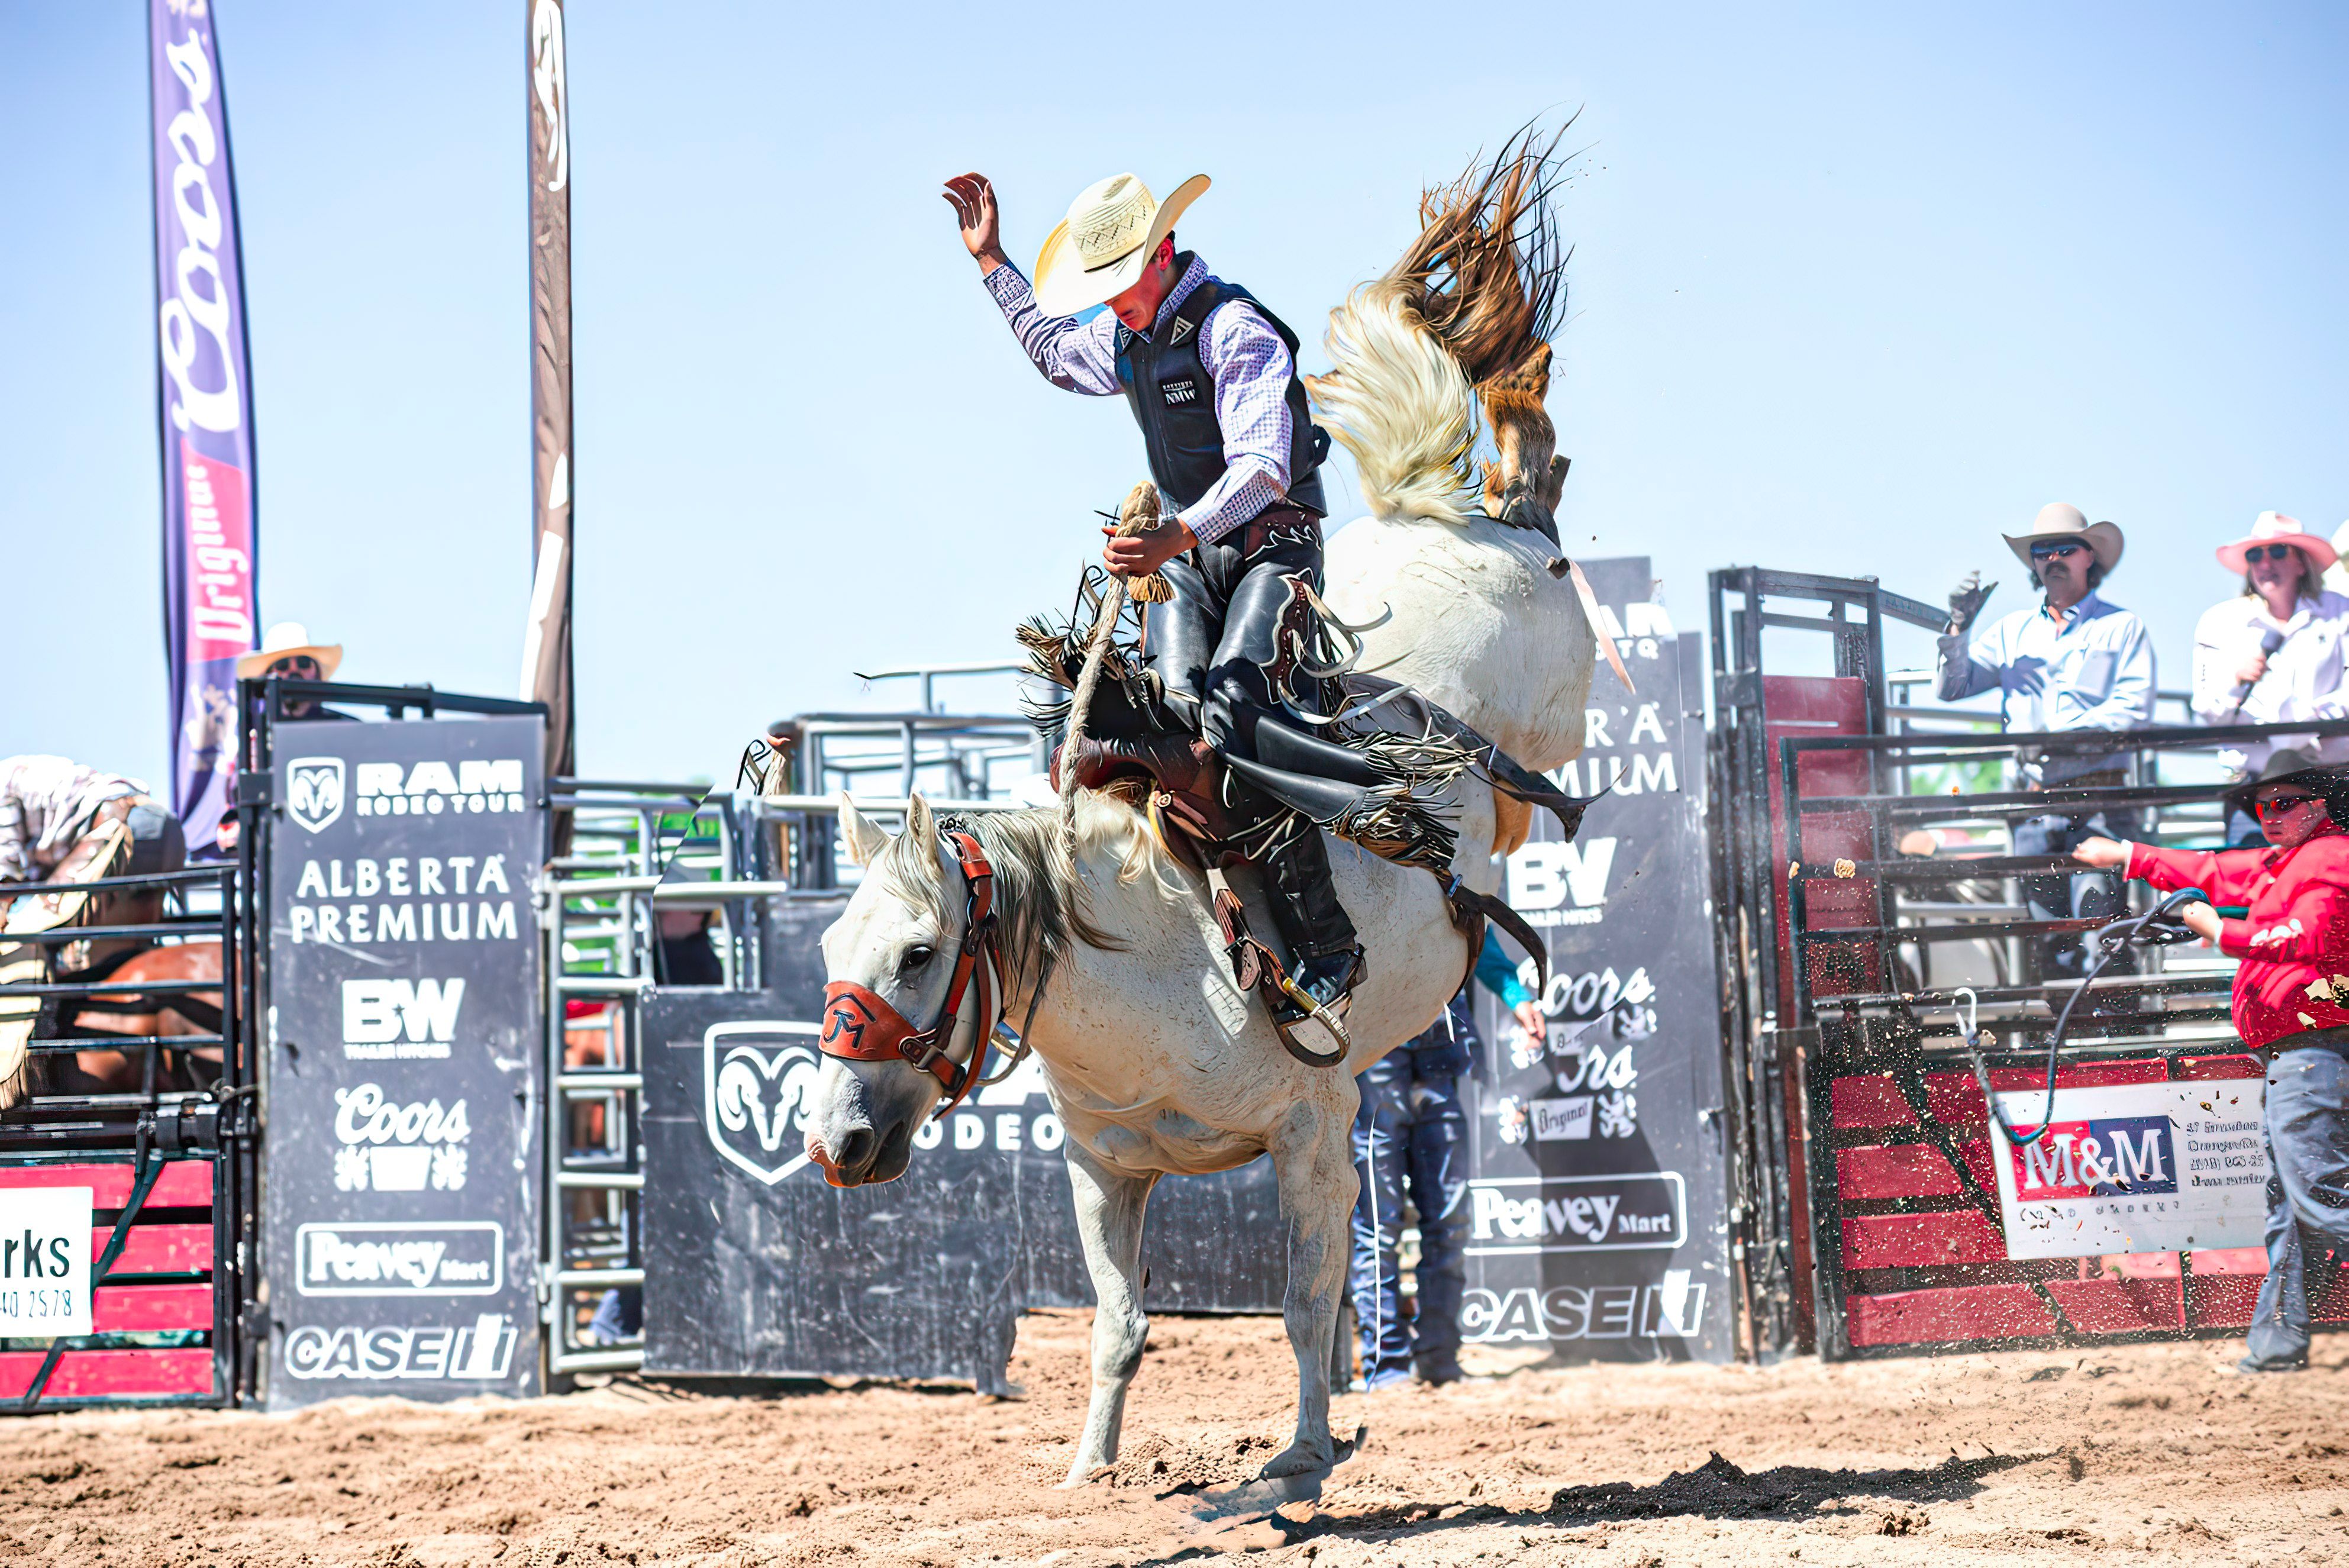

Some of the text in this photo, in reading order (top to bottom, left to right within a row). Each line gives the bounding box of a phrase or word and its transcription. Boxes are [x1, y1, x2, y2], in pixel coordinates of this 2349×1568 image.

[357, 760, 523, 796] RAM
[1545, 752, 1678, 797] MIUM
[356, 794, 524, 815] RODEO TOUR
[296, 856, 510, 898] ALBERTA
[290, 902, 518, 944] PREMIUM
[342, 977, 466, 1043] BW
[334, 1083, 471, 1144] Coors
[913, 1113, 1065, 1151] ODEO
[1470, 1188, 1671, 1243] Peavey Mart
[4, 1230, 70, 1278] rks
[308, 1232, 446, 1288] Peavey
